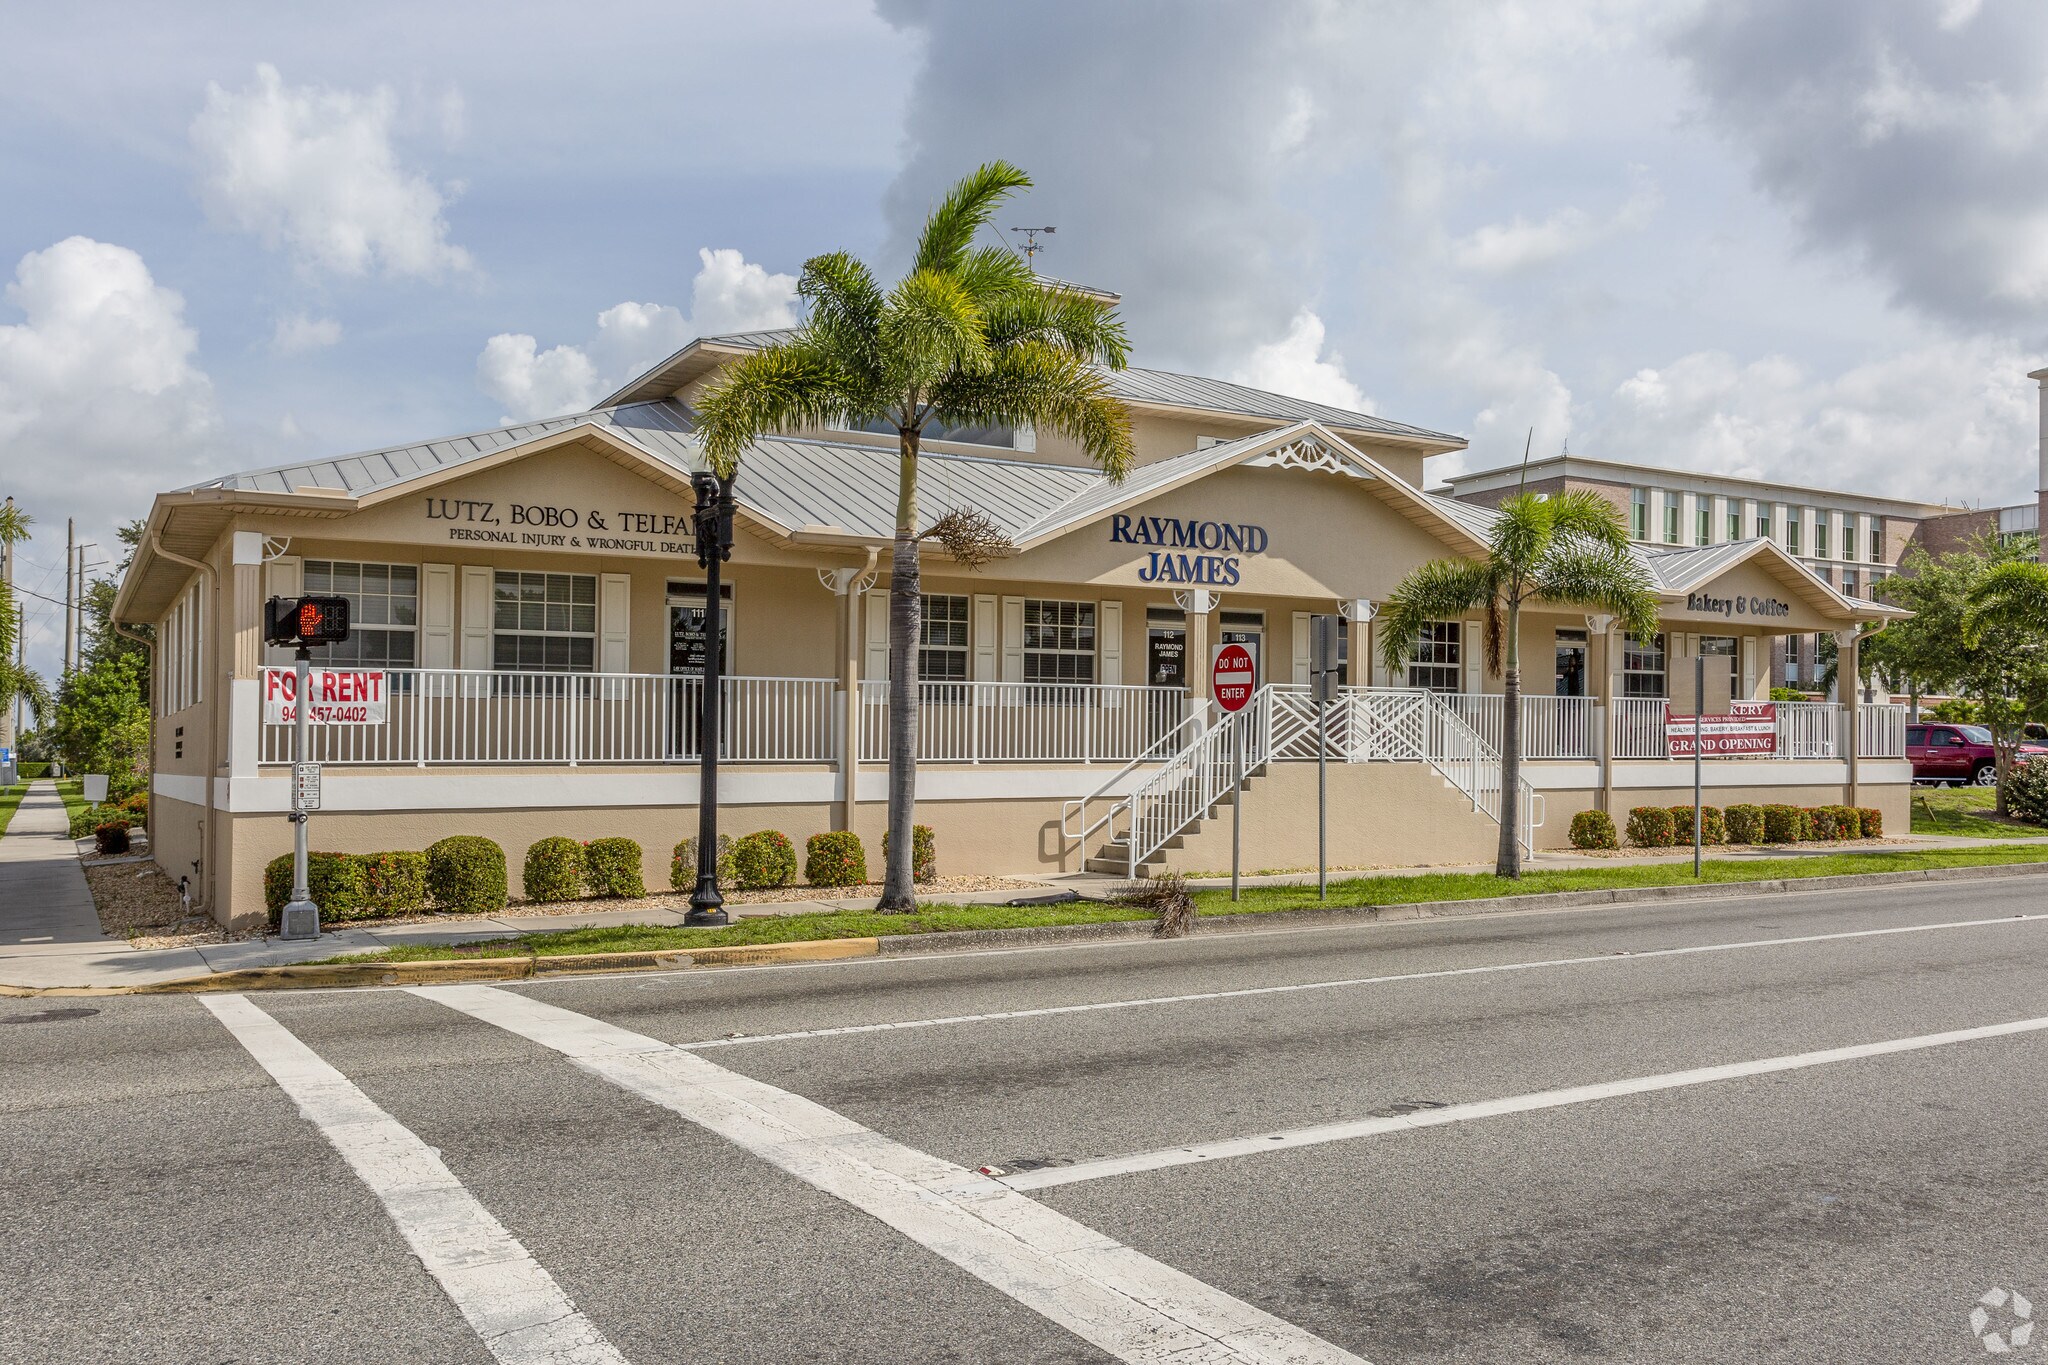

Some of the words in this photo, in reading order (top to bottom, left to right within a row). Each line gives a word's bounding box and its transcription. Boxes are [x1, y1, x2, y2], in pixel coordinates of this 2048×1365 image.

[426, 498, 500, 526] LUTZ,
[510, 504, 578, 528] BOBO
[588, 510, 608, 530] &
[618, 512, 696, 536] TELFAI
[450, 528, 518, 543] PERSONAL
[522, 533, 566, 547] INJURY
[570, 536, 582, 547] &
[586, 537, 657, 552] WRONGFUL
[1109, 514, 1269, 553] RAYMOND
[1138, 552, 1240, 587] JAMES
[1687, 592, 1733, 617] Bakery
[1736, 595, 1746, 614] &
[1750, 597, 1789, 617] Coffee
[692, 608, 705, 618] 111
[1163, 631, 1174, 639] 112
[1235, 634, 1246, 642] 113
[1155, 643, 1183, 651] RAYMOND
[1218, 658, 1229, 669] DO
[1233, 657, 1248, 669] NOT
[322, 672, 383, 702] RENT
[1221, 687, 1245, 699] ENTER
[282, 706, 367, 722] 94457-0402
[1730, 705, 1764, 715] KERY
[1670, 740, 1716, 752] GRAND
[1719, 738, 1771, 750] OPENING
